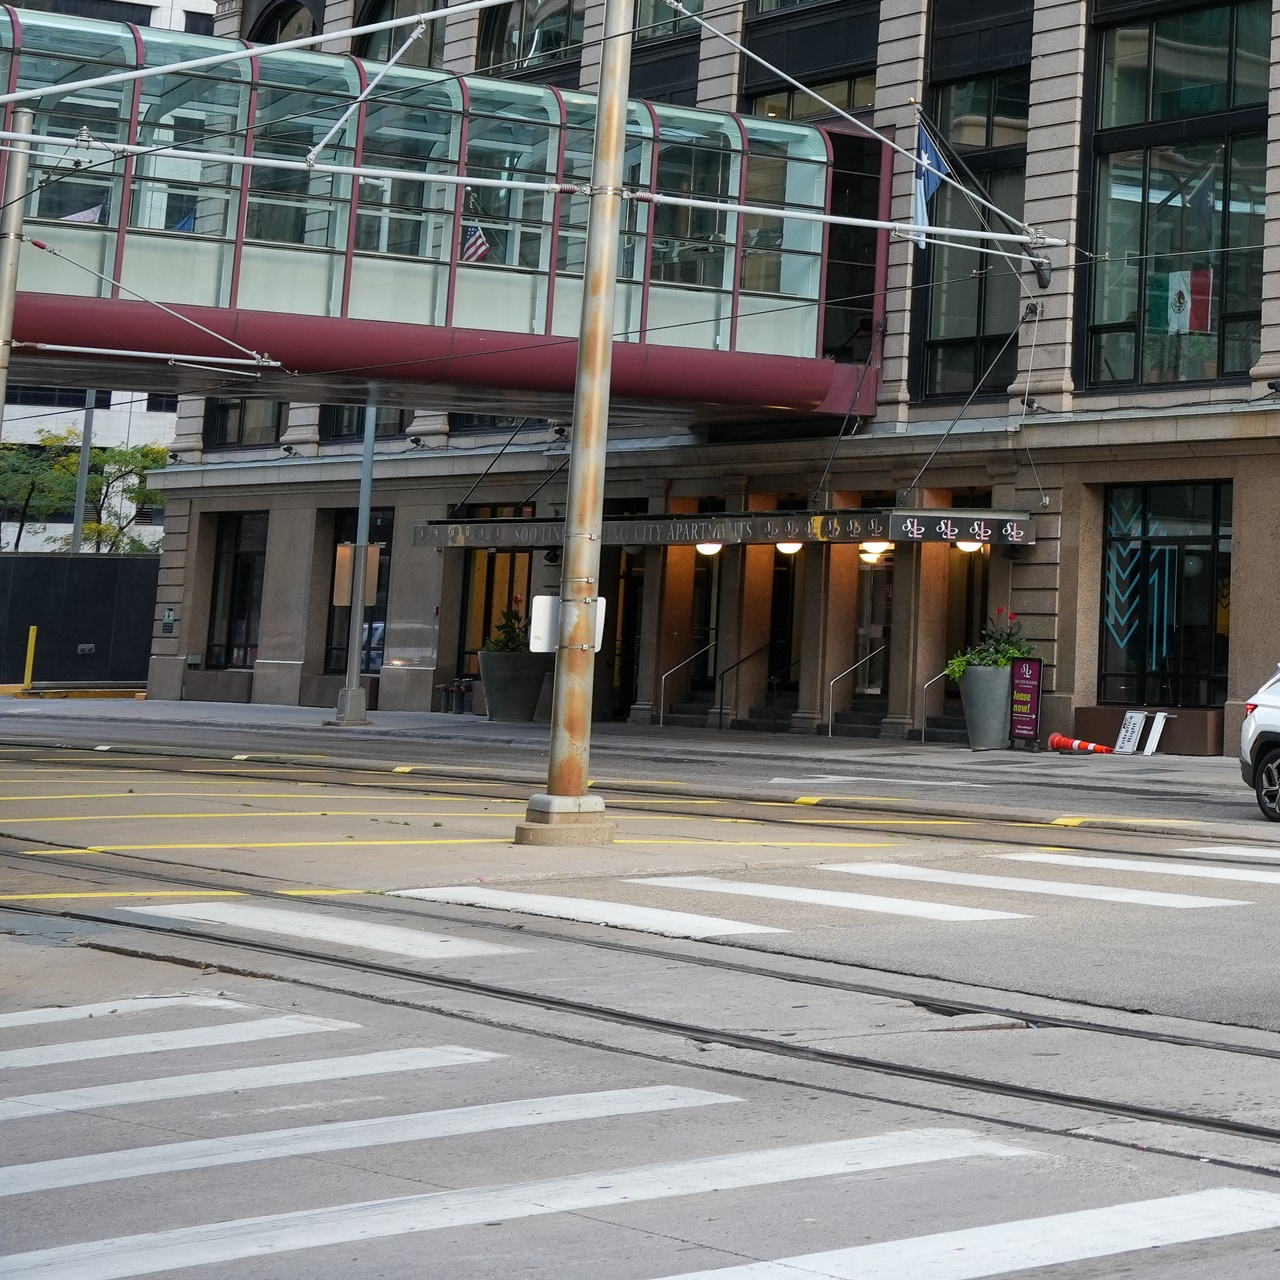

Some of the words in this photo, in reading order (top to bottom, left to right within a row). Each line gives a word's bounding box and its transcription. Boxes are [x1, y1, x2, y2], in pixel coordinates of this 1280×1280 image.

[515, 526, 537, 543] SOO
[634, 524, 664, 542] CITY
[667, 521, 753, 541] APARTMENTS
[1013, 690, 1032, 702] lease
[1013, 703, 1031, 713] now!
[1126, 722, 1138, 743] Right
